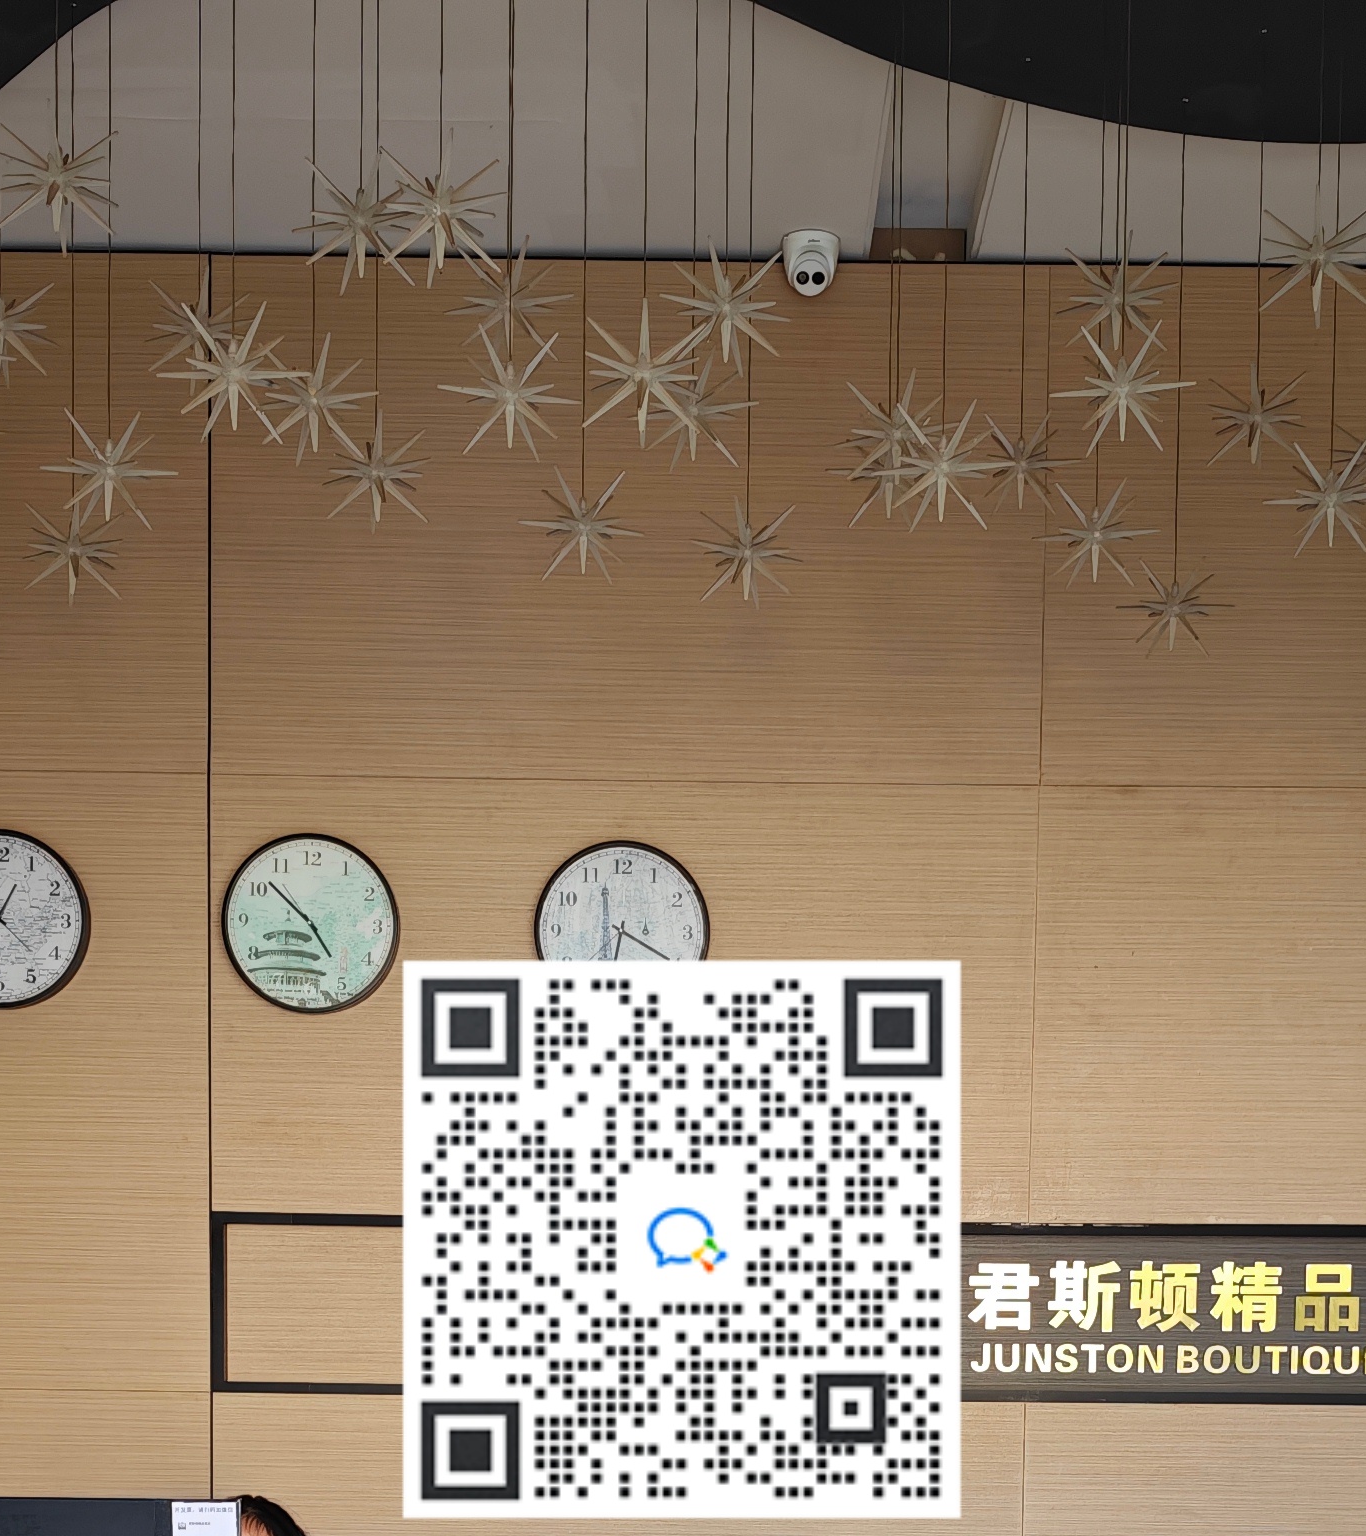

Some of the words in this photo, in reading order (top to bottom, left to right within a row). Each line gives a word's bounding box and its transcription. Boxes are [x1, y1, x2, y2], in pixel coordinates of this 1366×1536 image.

[28, 856, 36, 872] 1
[272, 858, 290, 874] 11
[303, 851, 322, 866] 12
[342, 861, 350, 876] 1
[612, 859, 633, 875] 12
[582, 868, 600, 883] 11
[650, 868, 659, 883] 1
[49, 881, 61, 896] 2
[249, 882, 268, 897] 10
[364, 887, 375, 901] 2
[558, 891, 577, 907] 10
[671, 892, 683, 908] 2
[60, 913, 72, 929] 3
[238, 913, 249, 927] 9
[372, 919, 383, 934] 3
[551, 924, 562, 938] 9
[682, 925, 693, 940] 3
[48, 946, 61, 960] 4
[248, 946, 259, 960] 8
[361, 951, 374, 966] 4
[25, 969, 37, 984] 5
[337, 977, 347, 990] 5
[970, 1343, 1164, 1375] JUNSTON
